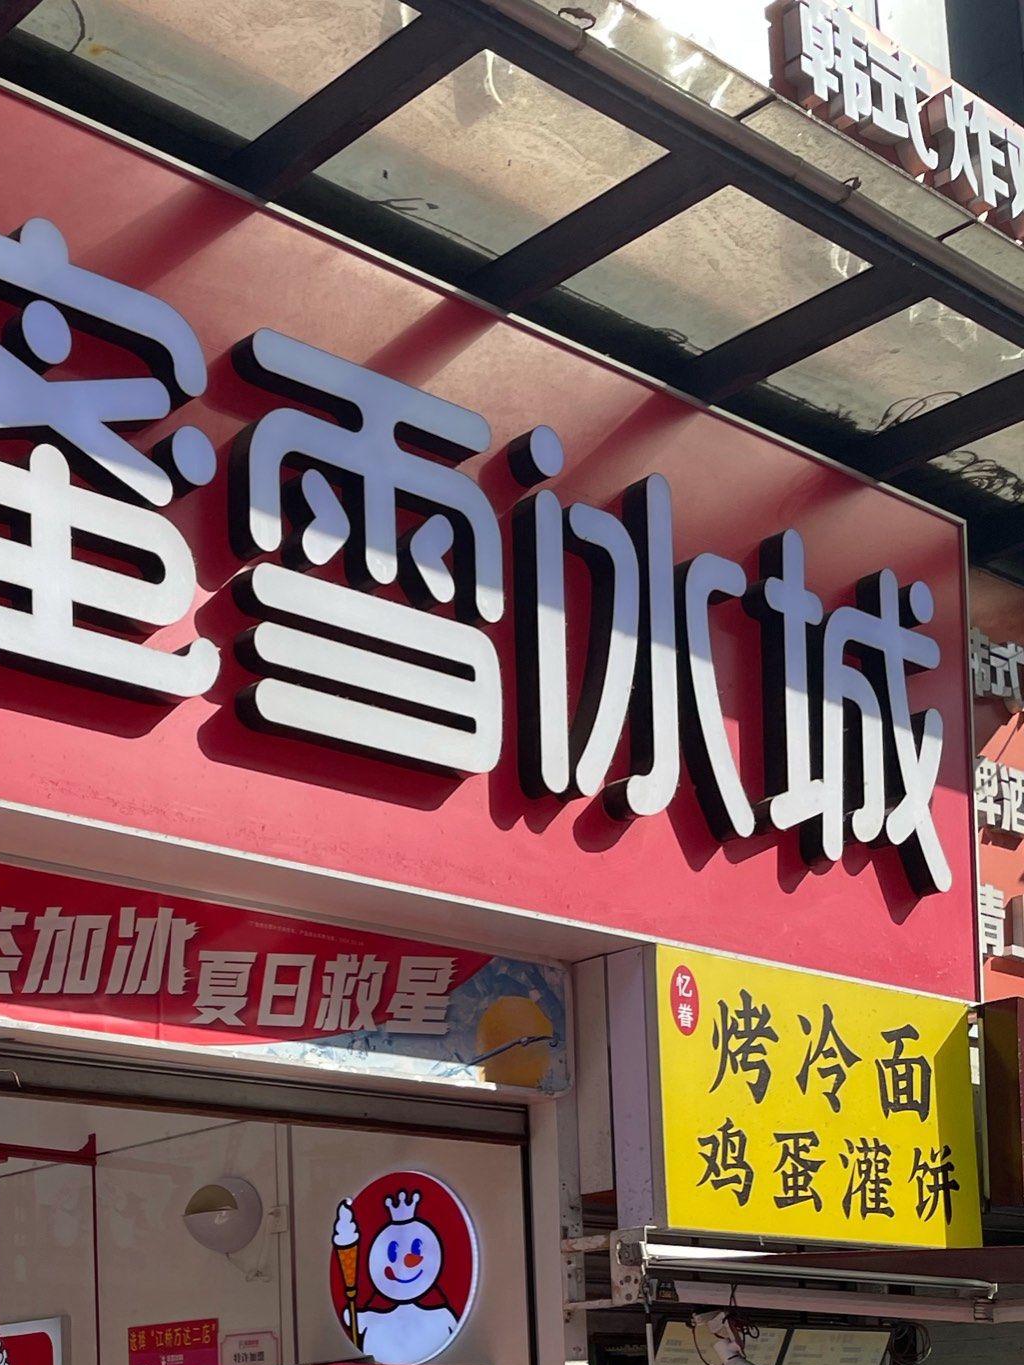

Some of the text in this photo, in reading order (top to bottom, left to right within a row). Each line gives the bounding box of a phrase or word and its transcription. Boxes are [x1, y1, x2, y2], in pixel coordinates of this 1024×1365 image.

[800, 0, 1024, 218] 韩式炸
[191, 951, 458, 1036] 夏日救星
[709, 989, 932, 1122] 烤冷面
[696, 1117, 961, 1225] 鸡蛋灌饼
